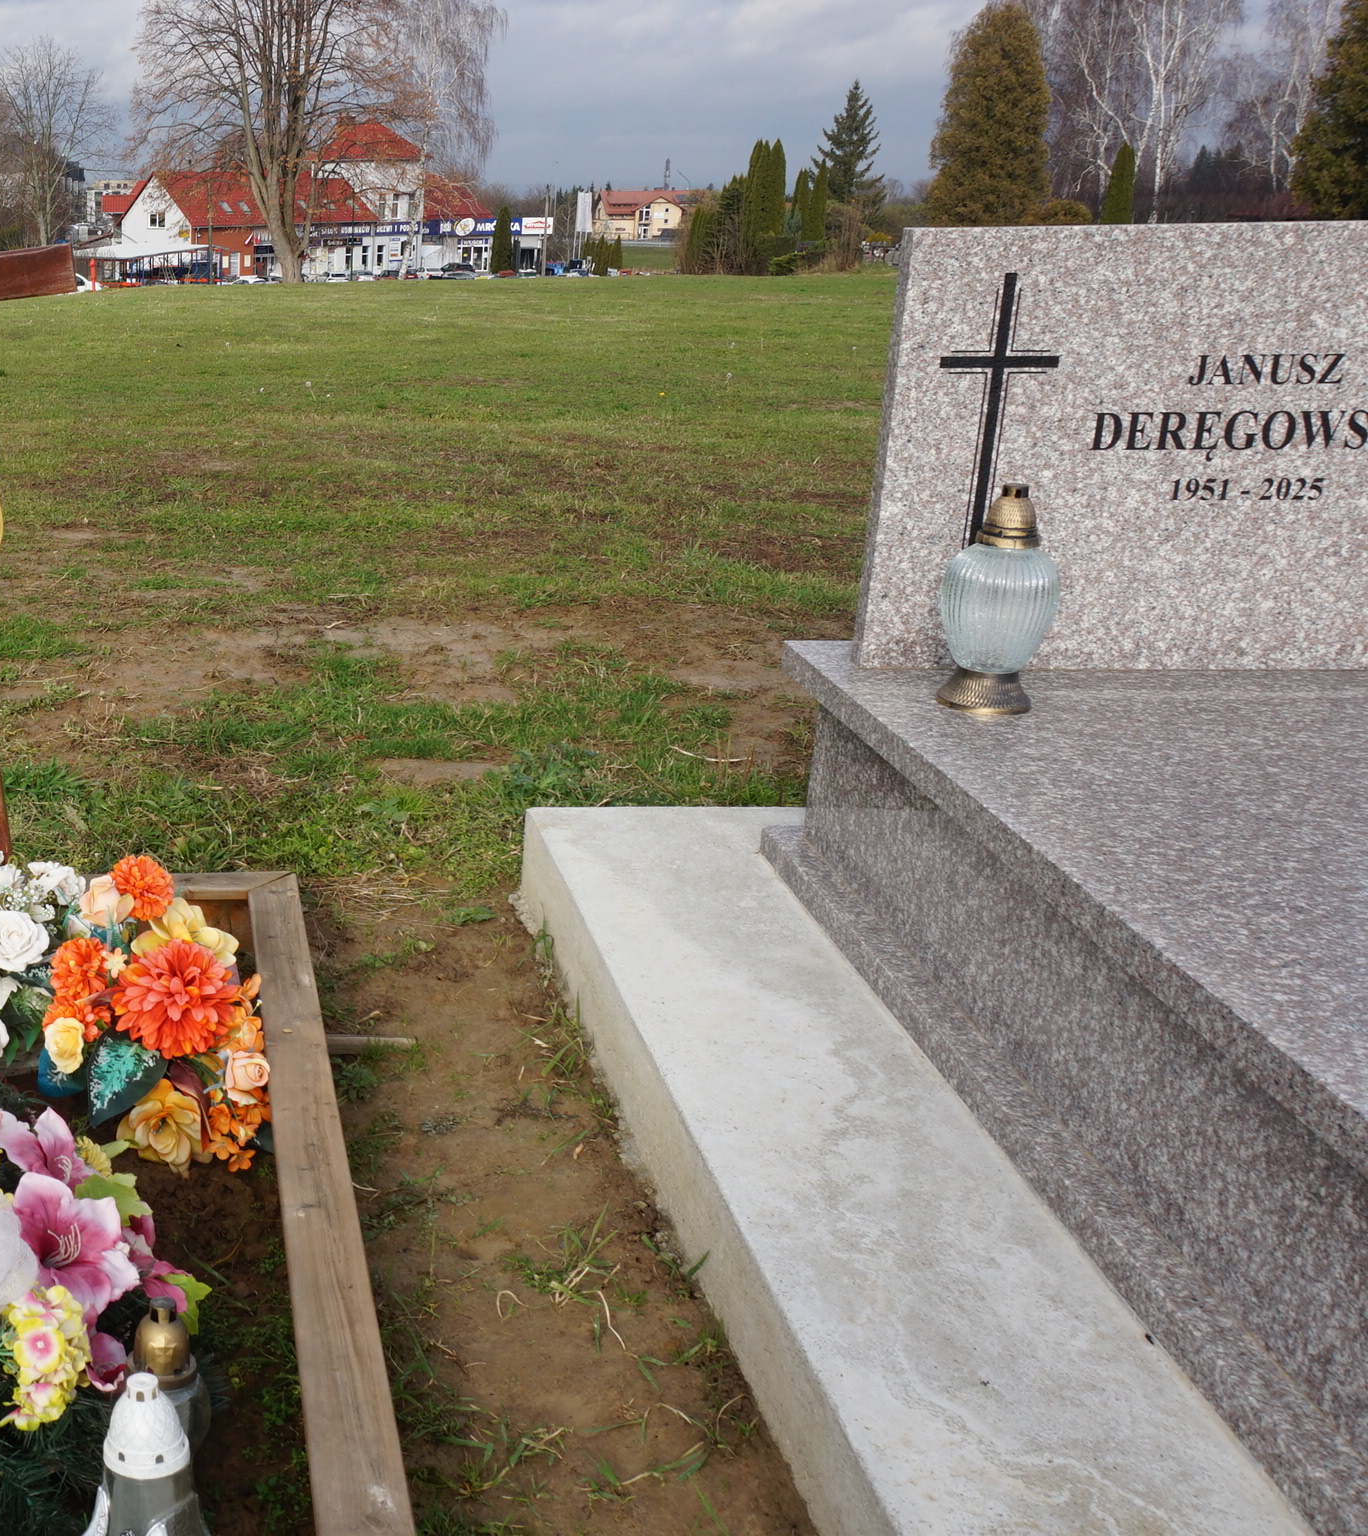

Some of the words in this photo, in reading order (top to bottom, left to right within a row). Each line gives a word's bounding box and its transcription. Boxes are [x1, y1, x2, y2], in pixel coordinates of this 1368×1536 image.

[340, 224, 371, 234] KOMNKÓW
[476, 220, 521, 232] MRÓKA
[1188, 353, 1346, 386] JANUSZ
[1089, 410, 1368, 462] DERĘGOWS
[1170, 477, 1233, 501] 1951
[1258, 476, 1326, 501] 2025
